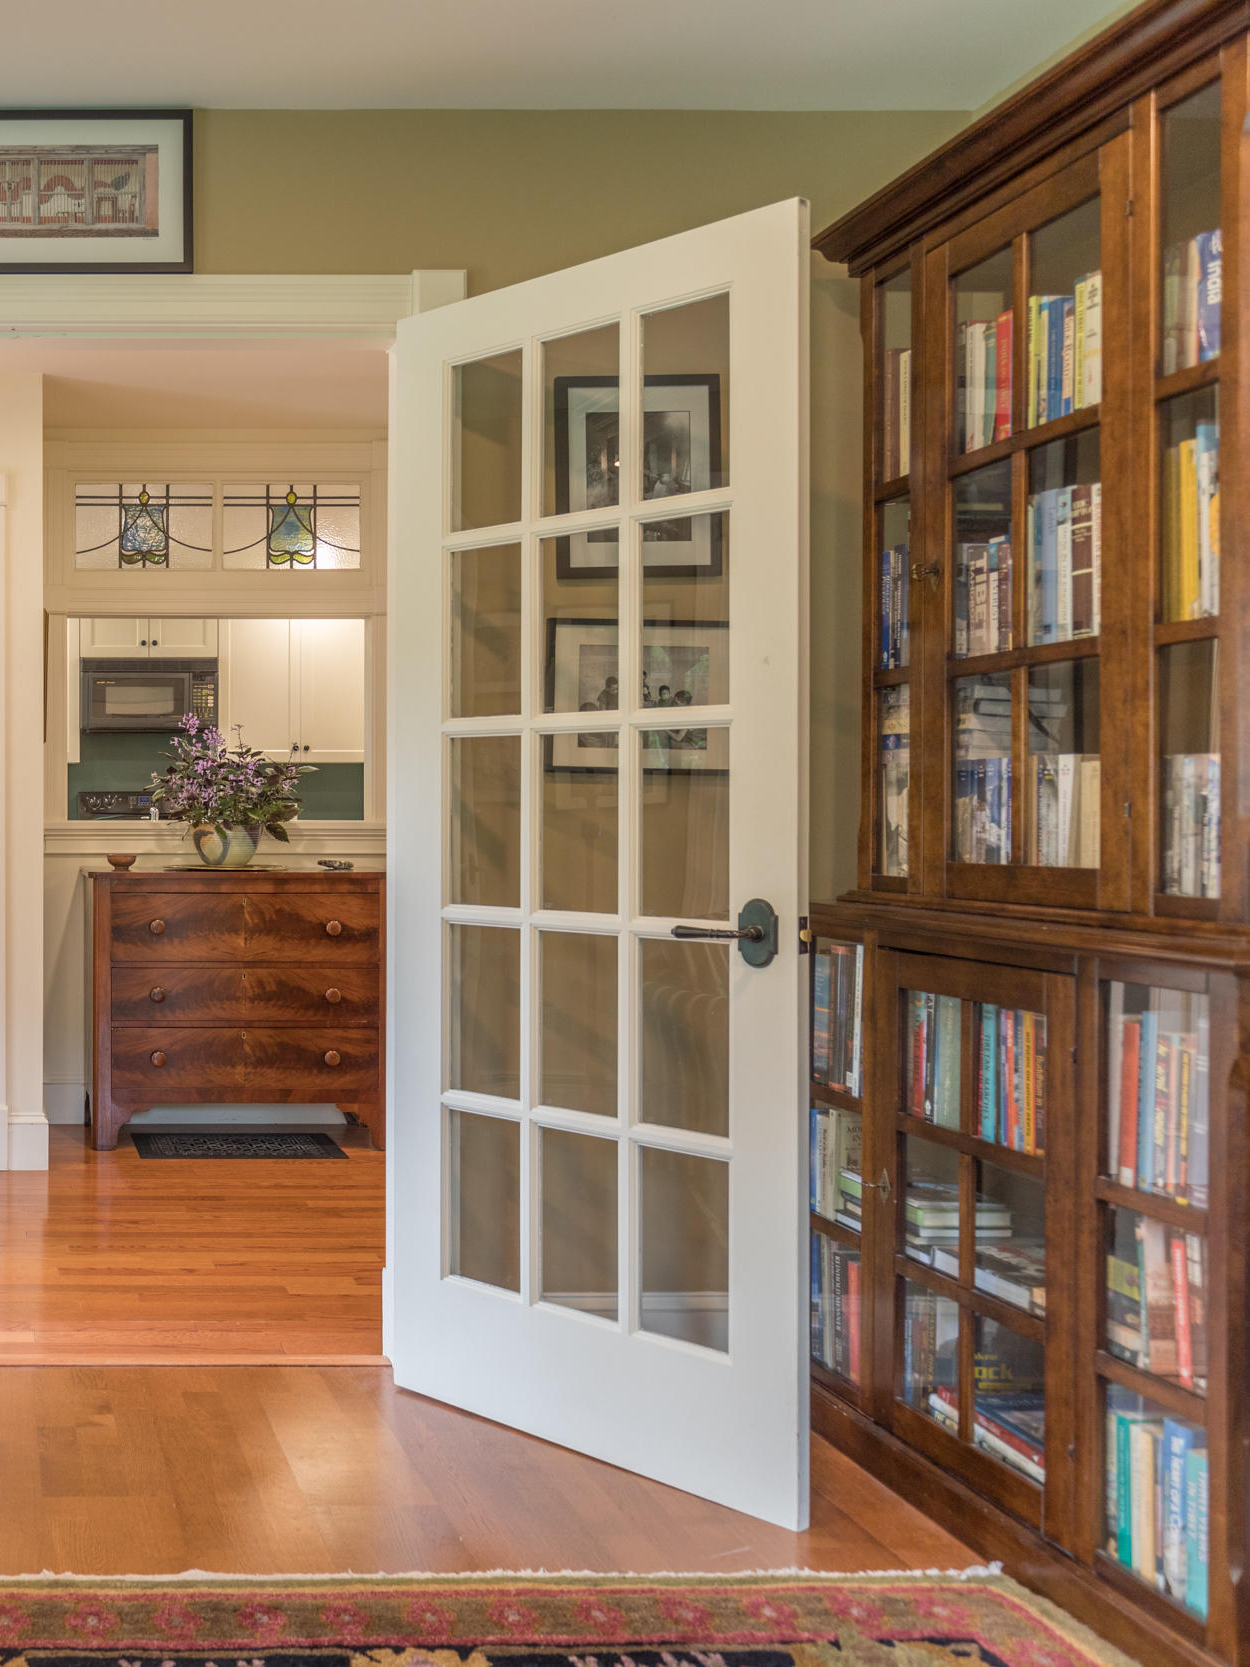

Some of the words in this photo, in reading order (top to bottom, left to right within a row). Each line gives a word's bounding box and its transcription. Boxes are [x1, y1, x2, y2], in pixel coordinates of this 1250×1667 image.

[1207, 259, 1222, 304] India
[968, 561, 976, 637] HANDBOOK
[975, 552, 987, 642] TIBET
[983, 1034, 991, 1071] TIBETAN
[1036, 1055, 1045, 1095] Buddhism
[974, 1362, 1014, 1380] ock
[1198, 1472, 1207, 1514] THREE
[1187, 1500, 1196, 1540] TIBET
[1198, 1517, 1207, 1562] YEARS
